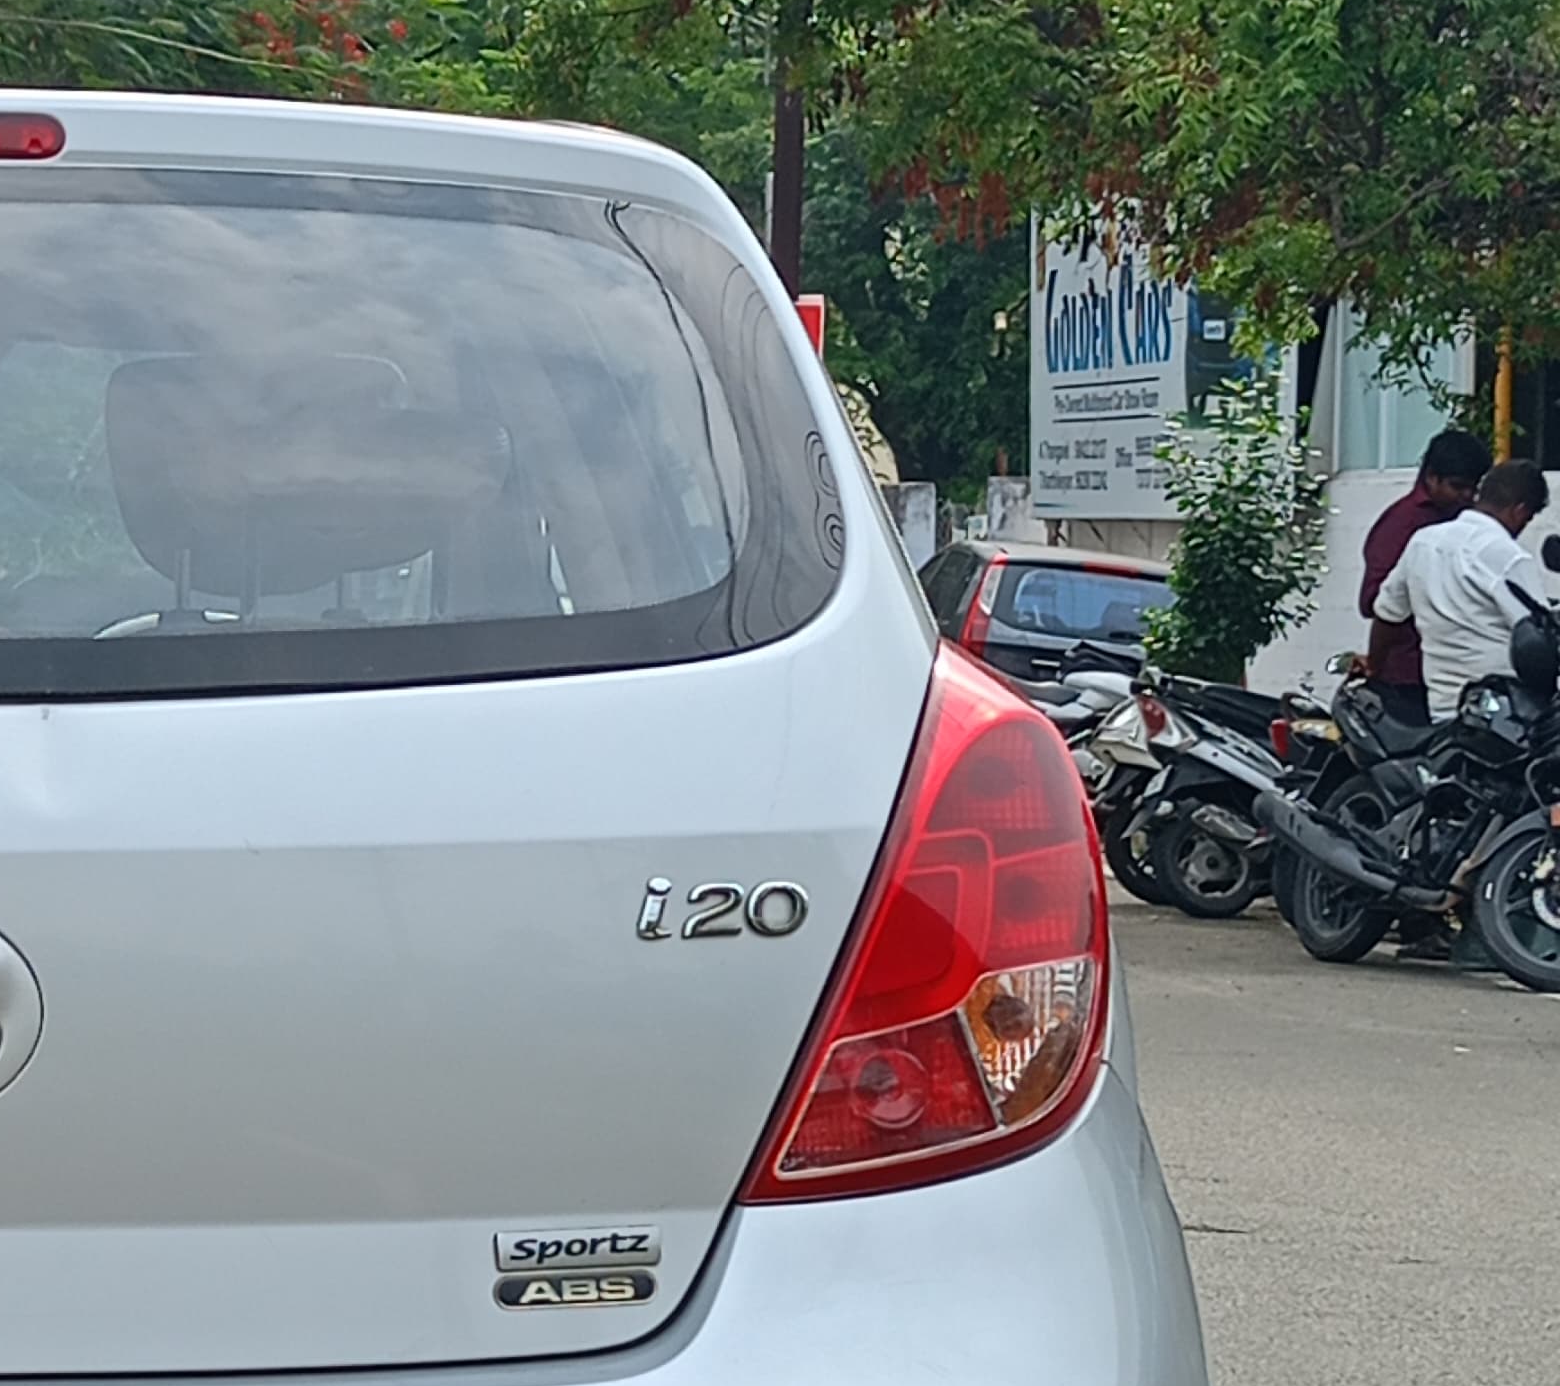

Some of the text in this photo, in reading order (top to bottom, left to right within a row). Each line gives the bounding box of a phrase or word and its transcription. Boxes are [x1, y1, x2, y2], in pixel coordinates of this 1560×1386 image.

[1119, 256, 1172, 366] CARS
[637, 876, 810, 941] i20
[519, 1276, 636, 1304] ABS
